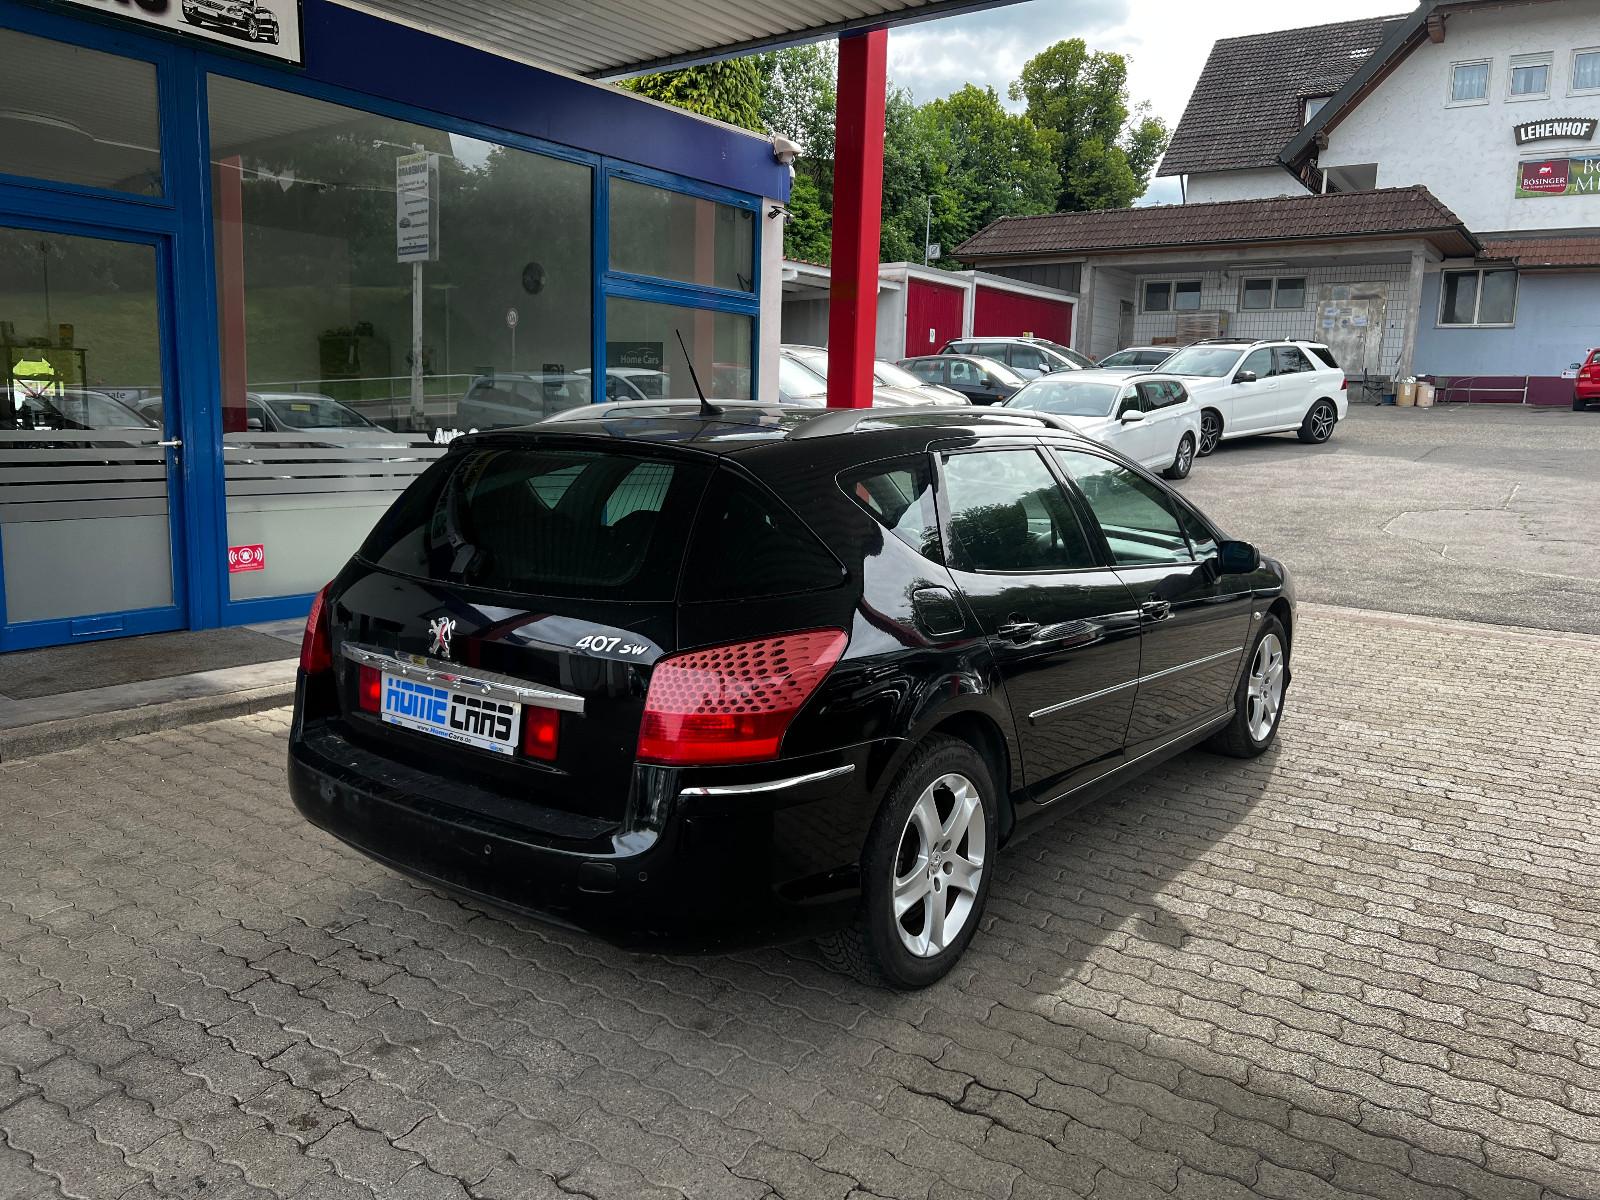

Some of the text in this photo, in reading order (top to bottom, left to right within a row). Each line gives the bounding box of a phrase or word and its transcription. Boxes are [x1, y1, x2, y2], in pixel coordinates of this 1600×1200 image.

[1520, 122, 1591, 141] LEHENHOF
[620, 354, 660, 365] Home Cars
[575, 635, 622, 652] 407
[386, 677, 449, 725] HOME
[416, 723, 473, 744] www.HomeCars.de
